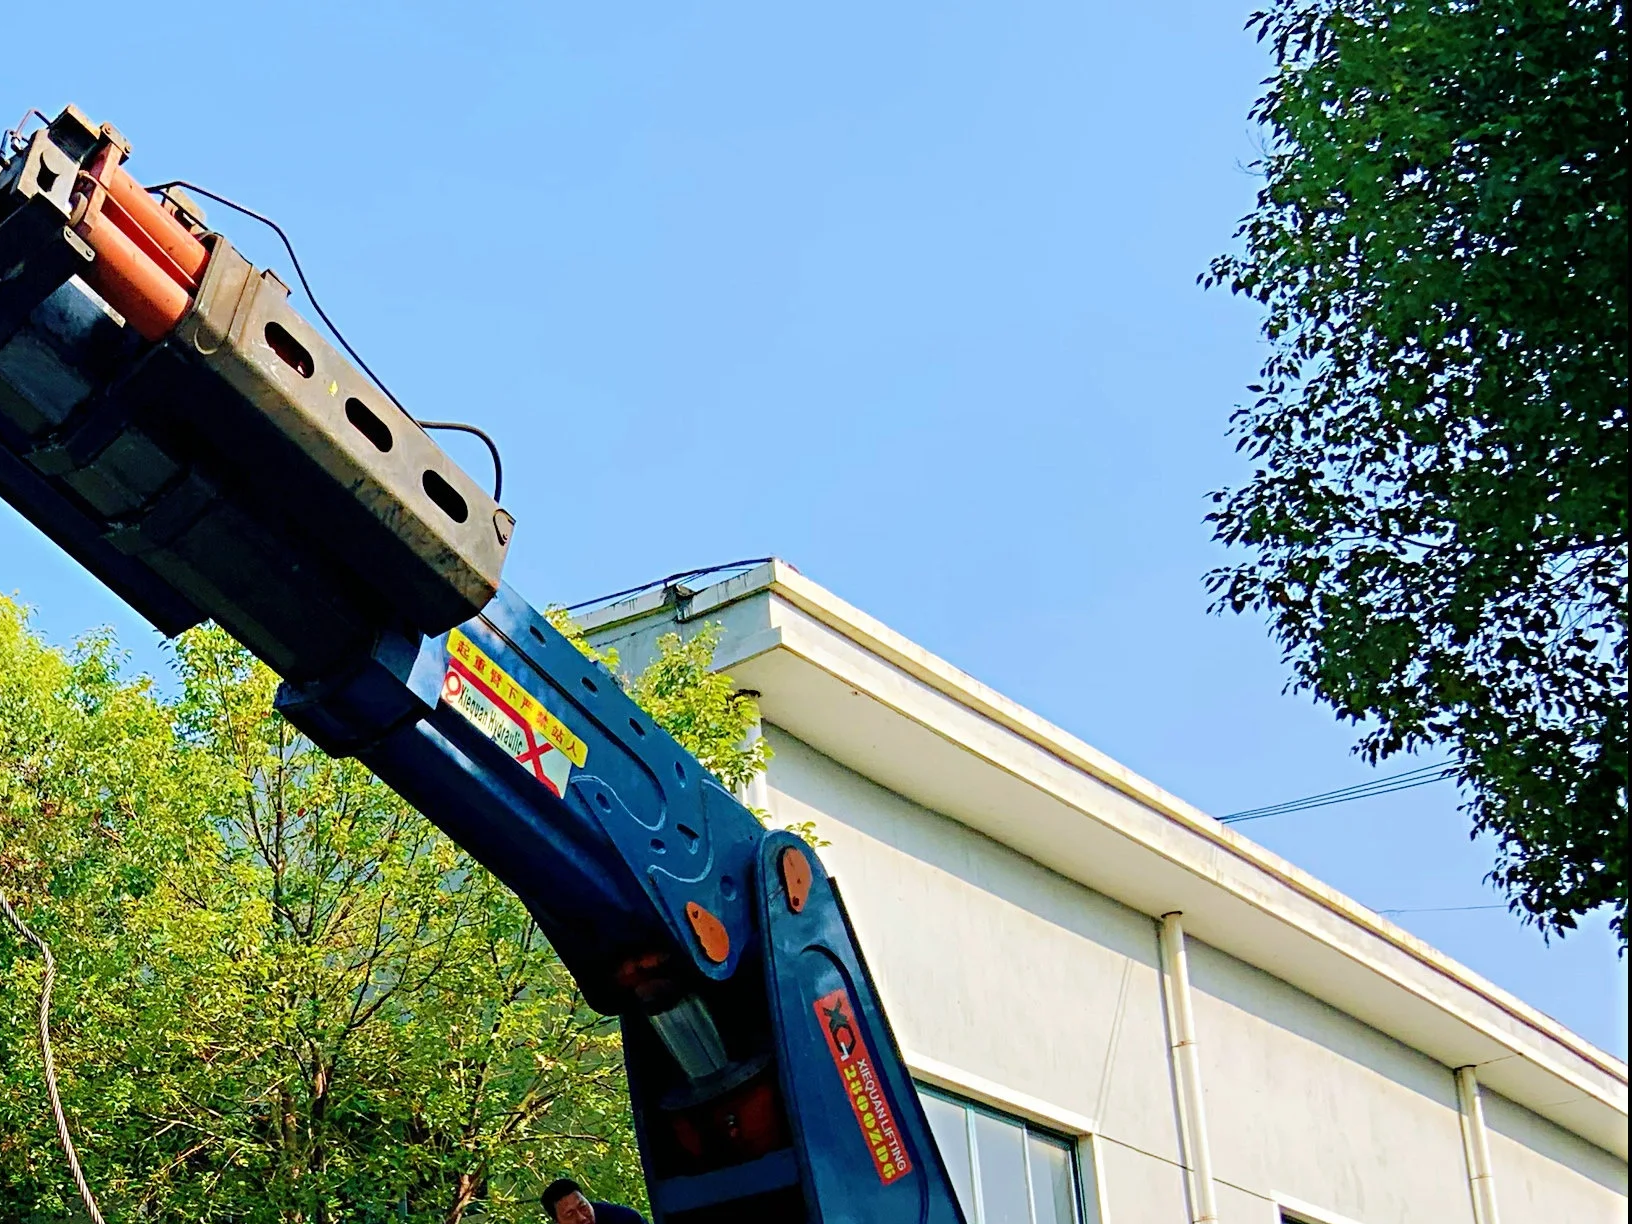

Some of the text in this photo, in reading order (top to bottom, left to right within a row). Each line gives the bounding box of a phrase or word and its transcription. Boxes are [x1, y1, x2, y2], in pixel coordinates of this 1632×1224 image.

[455, 638, 578, 759] 起重臂下严禁站人
[458, 684, 523, 755] Xiequan Hydraulic
[857, 1059, 906, 1171] XIEQUAN LIFTING
